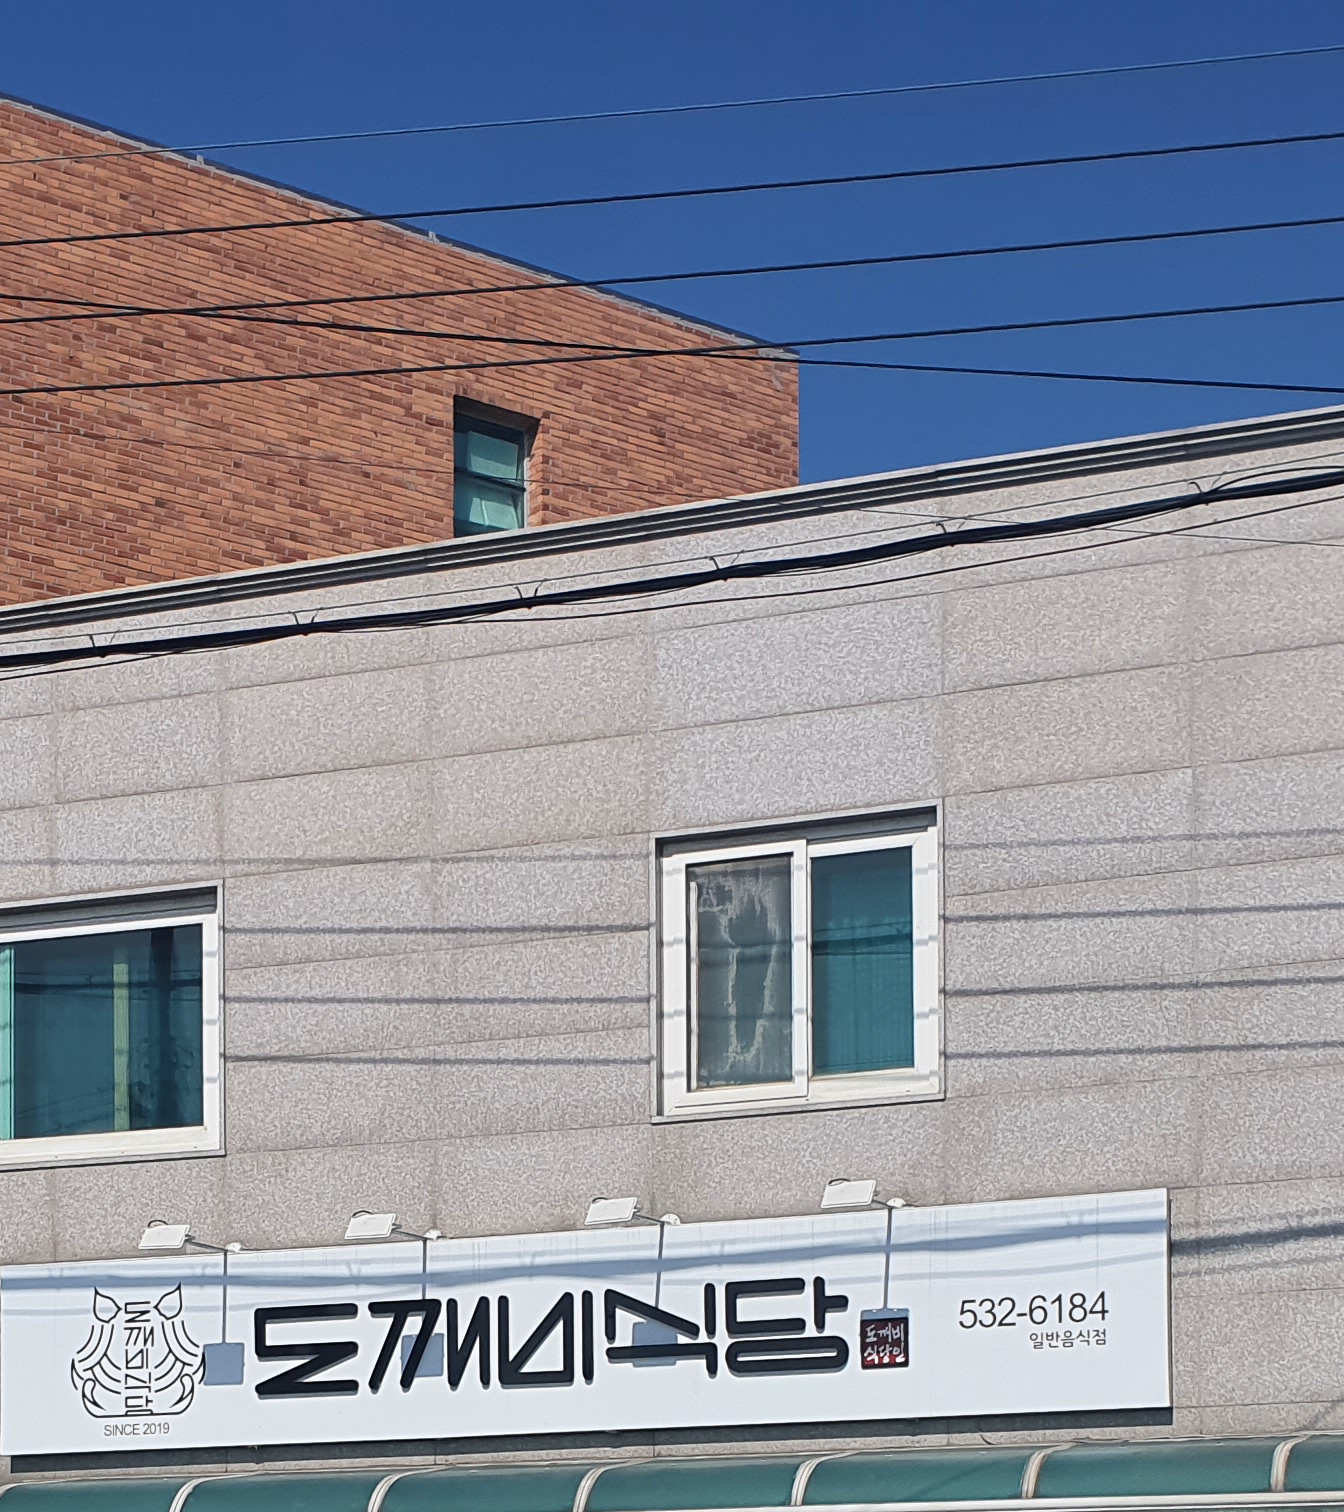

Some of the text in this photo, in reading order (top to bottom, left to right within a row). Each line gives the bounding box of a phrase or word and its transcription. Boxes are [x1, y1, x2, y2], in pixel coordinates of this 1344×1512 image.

[958, 1291, 1109, 1329] 532-6184
[256, 1276, 849, 1399] 도깨비식당
[865, 1322, 905, 1343] 도깨비
[1029, 1328, 1107, 1350] 일반음식점
[104, 1422, 170, 1437] SINCE 2019
